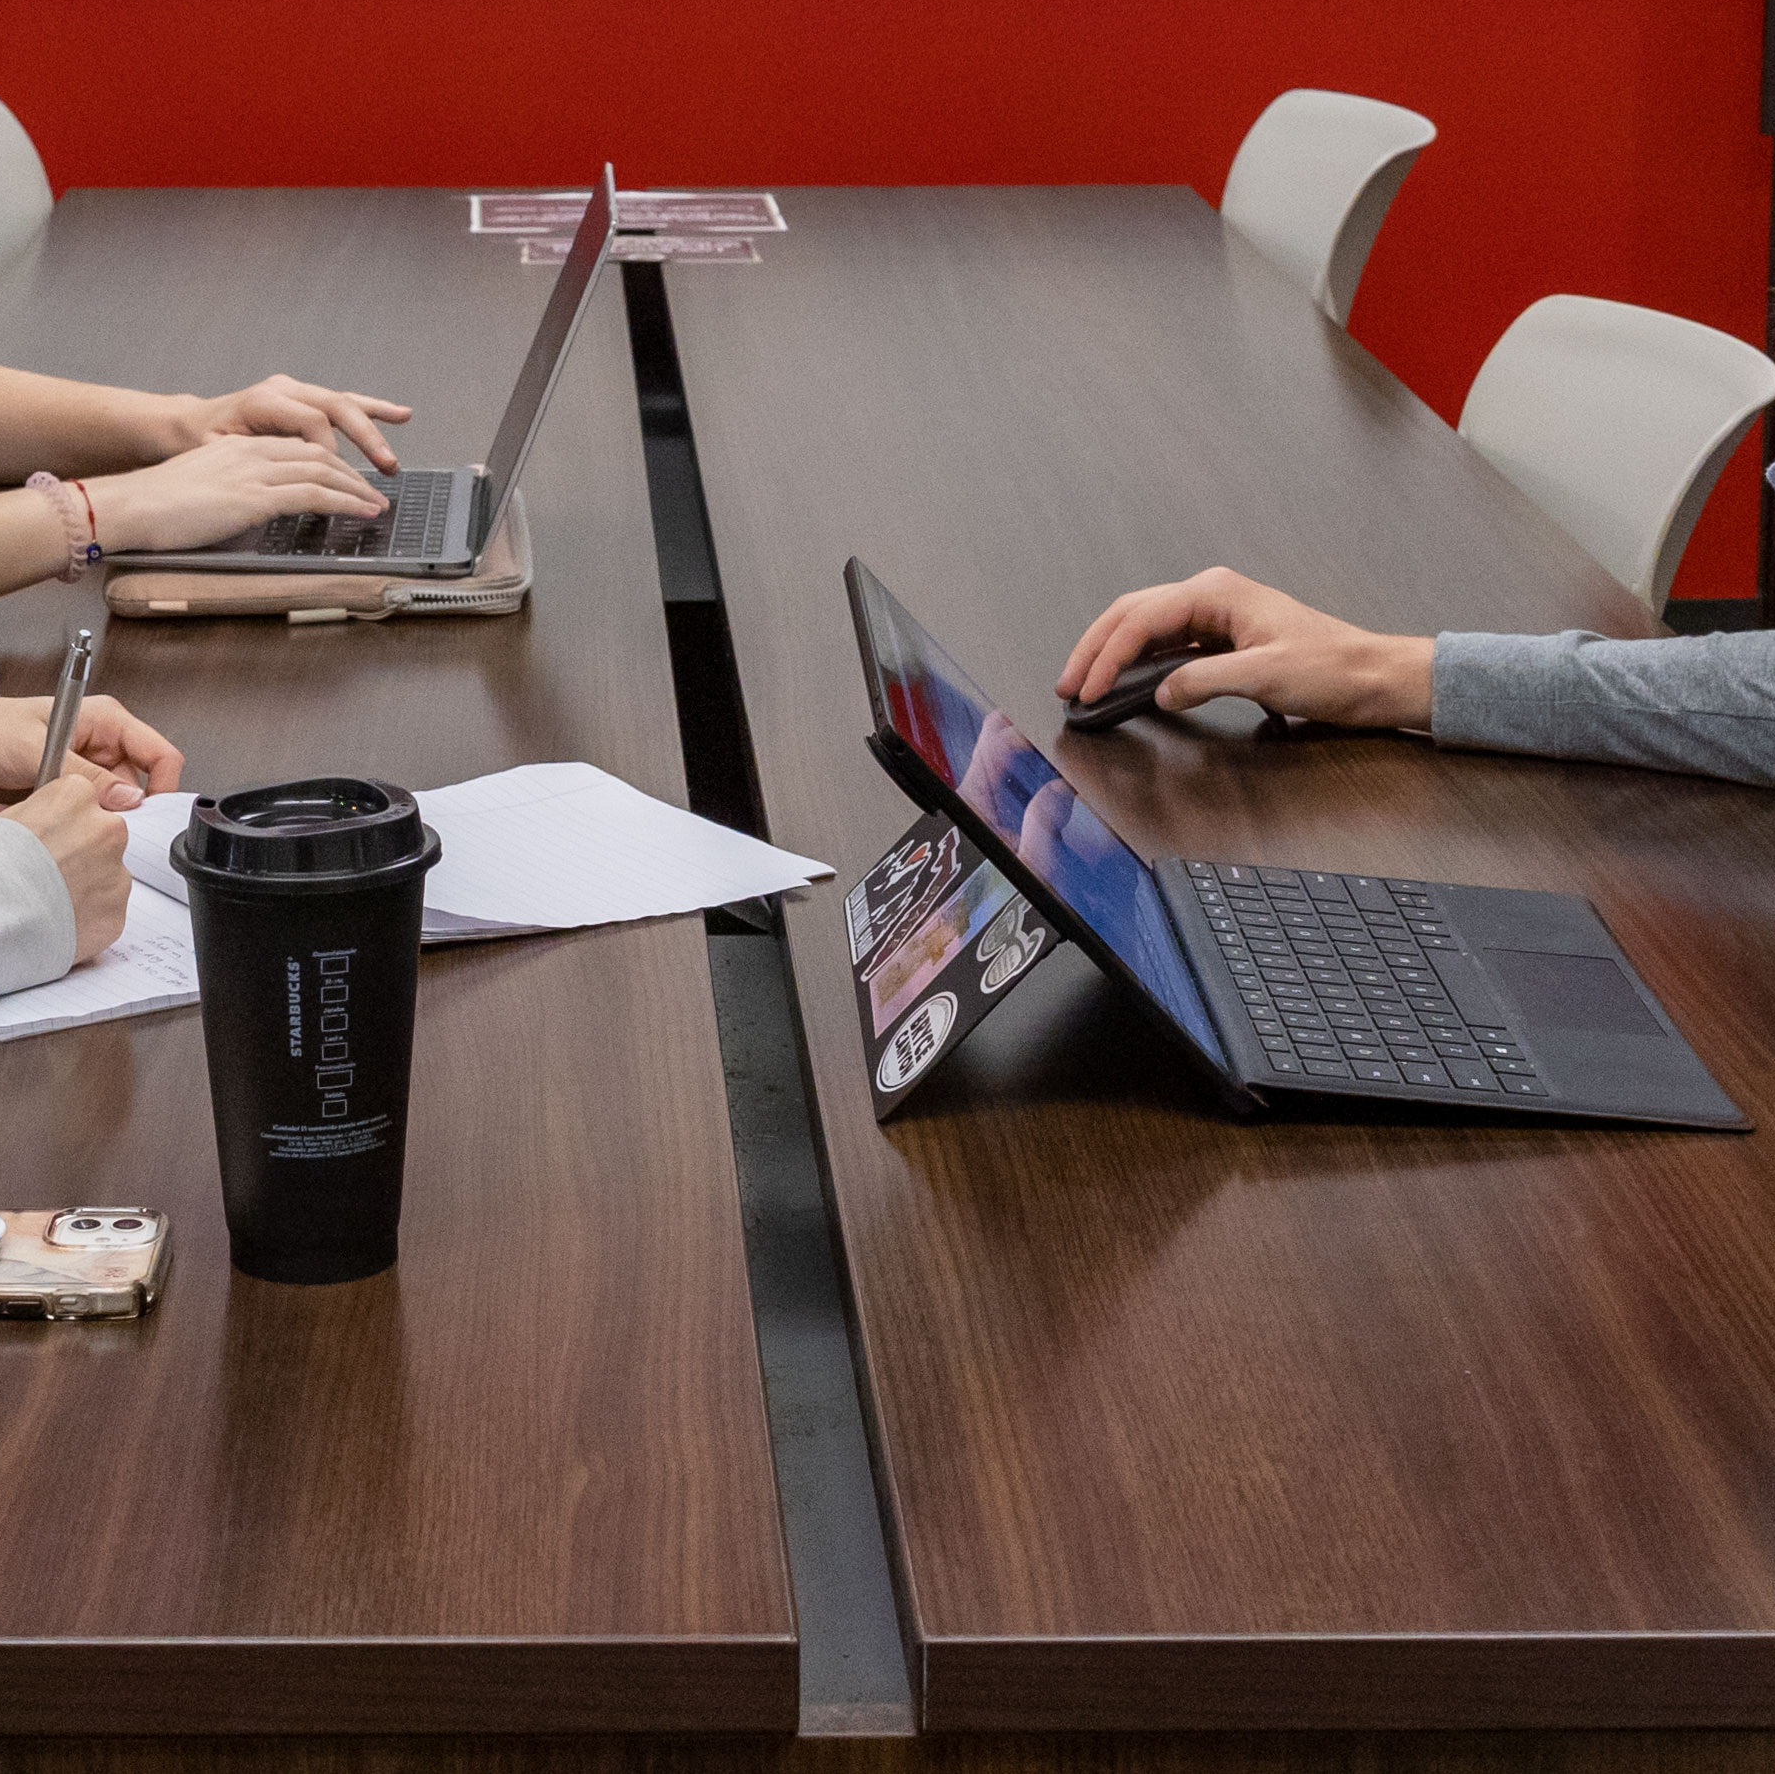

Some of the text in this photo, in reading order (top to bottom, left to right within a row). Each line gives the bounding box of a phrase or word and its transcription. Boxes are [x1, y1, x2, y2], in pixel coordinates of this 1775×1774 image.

[287, 961, 303, 1058] STARBUCKS
[910, 1008, 936, 1064] BRYCE
[894, 1029, 915, 1080] CANYON
